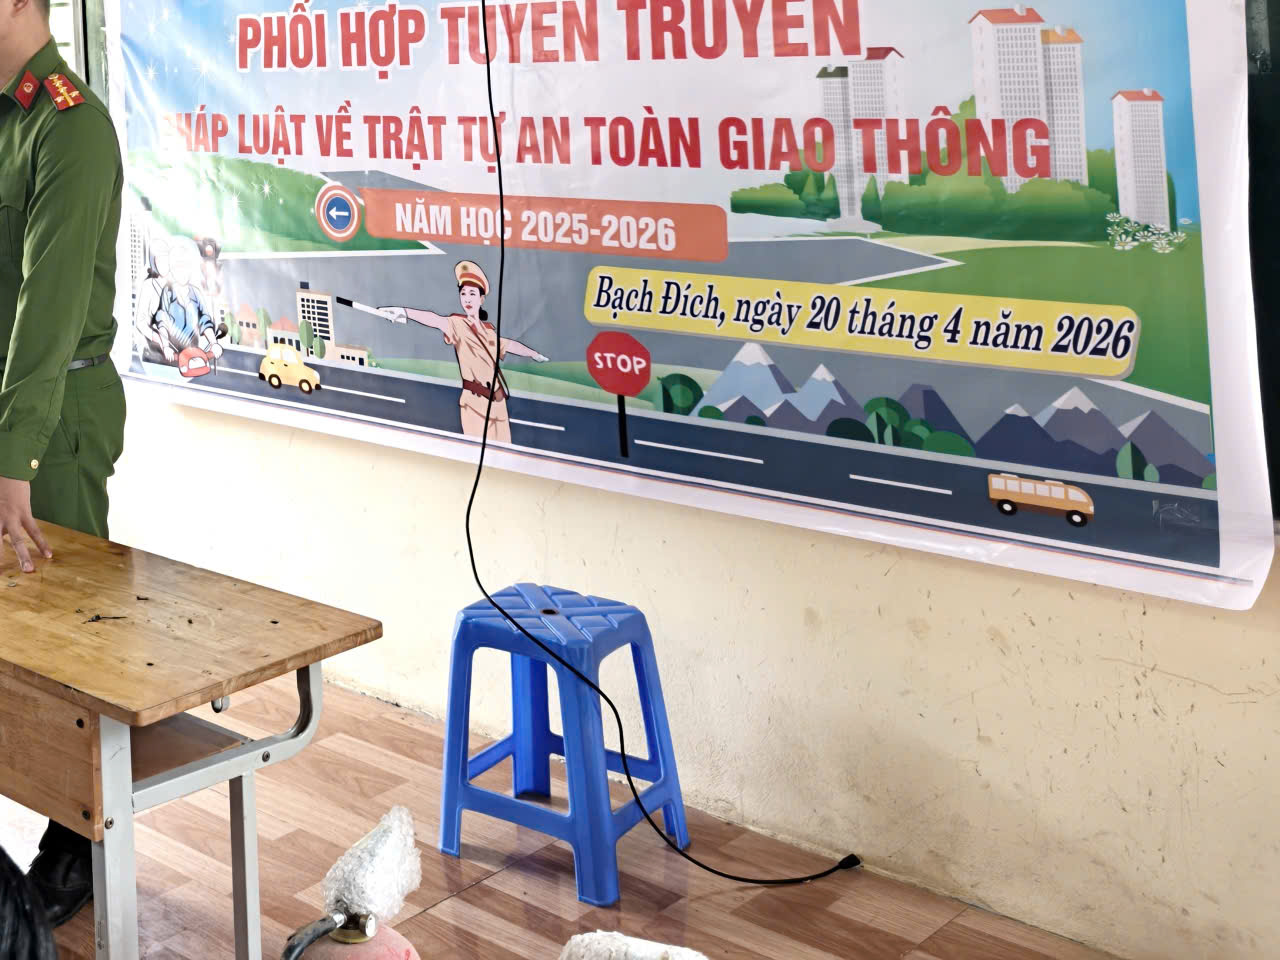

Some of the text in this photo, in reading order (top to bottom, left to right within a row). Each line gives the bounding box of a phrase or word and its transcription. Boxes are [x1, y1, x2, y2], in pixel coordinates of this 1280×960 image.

[340, 3, 425, 79] HỢP
[163, 100, 1051, 178] HÁP LUẬT VỀ TRẬT TỰ AN TOÀN GIAO THÔNG
[395, 198, 676, 252] NĂM HỌC 2025-2026
[593, 275, 1136, 360] Bạch Đích, ngày 20 tháng 4 năm 2026
[594, 351, 647, 377] STOP
